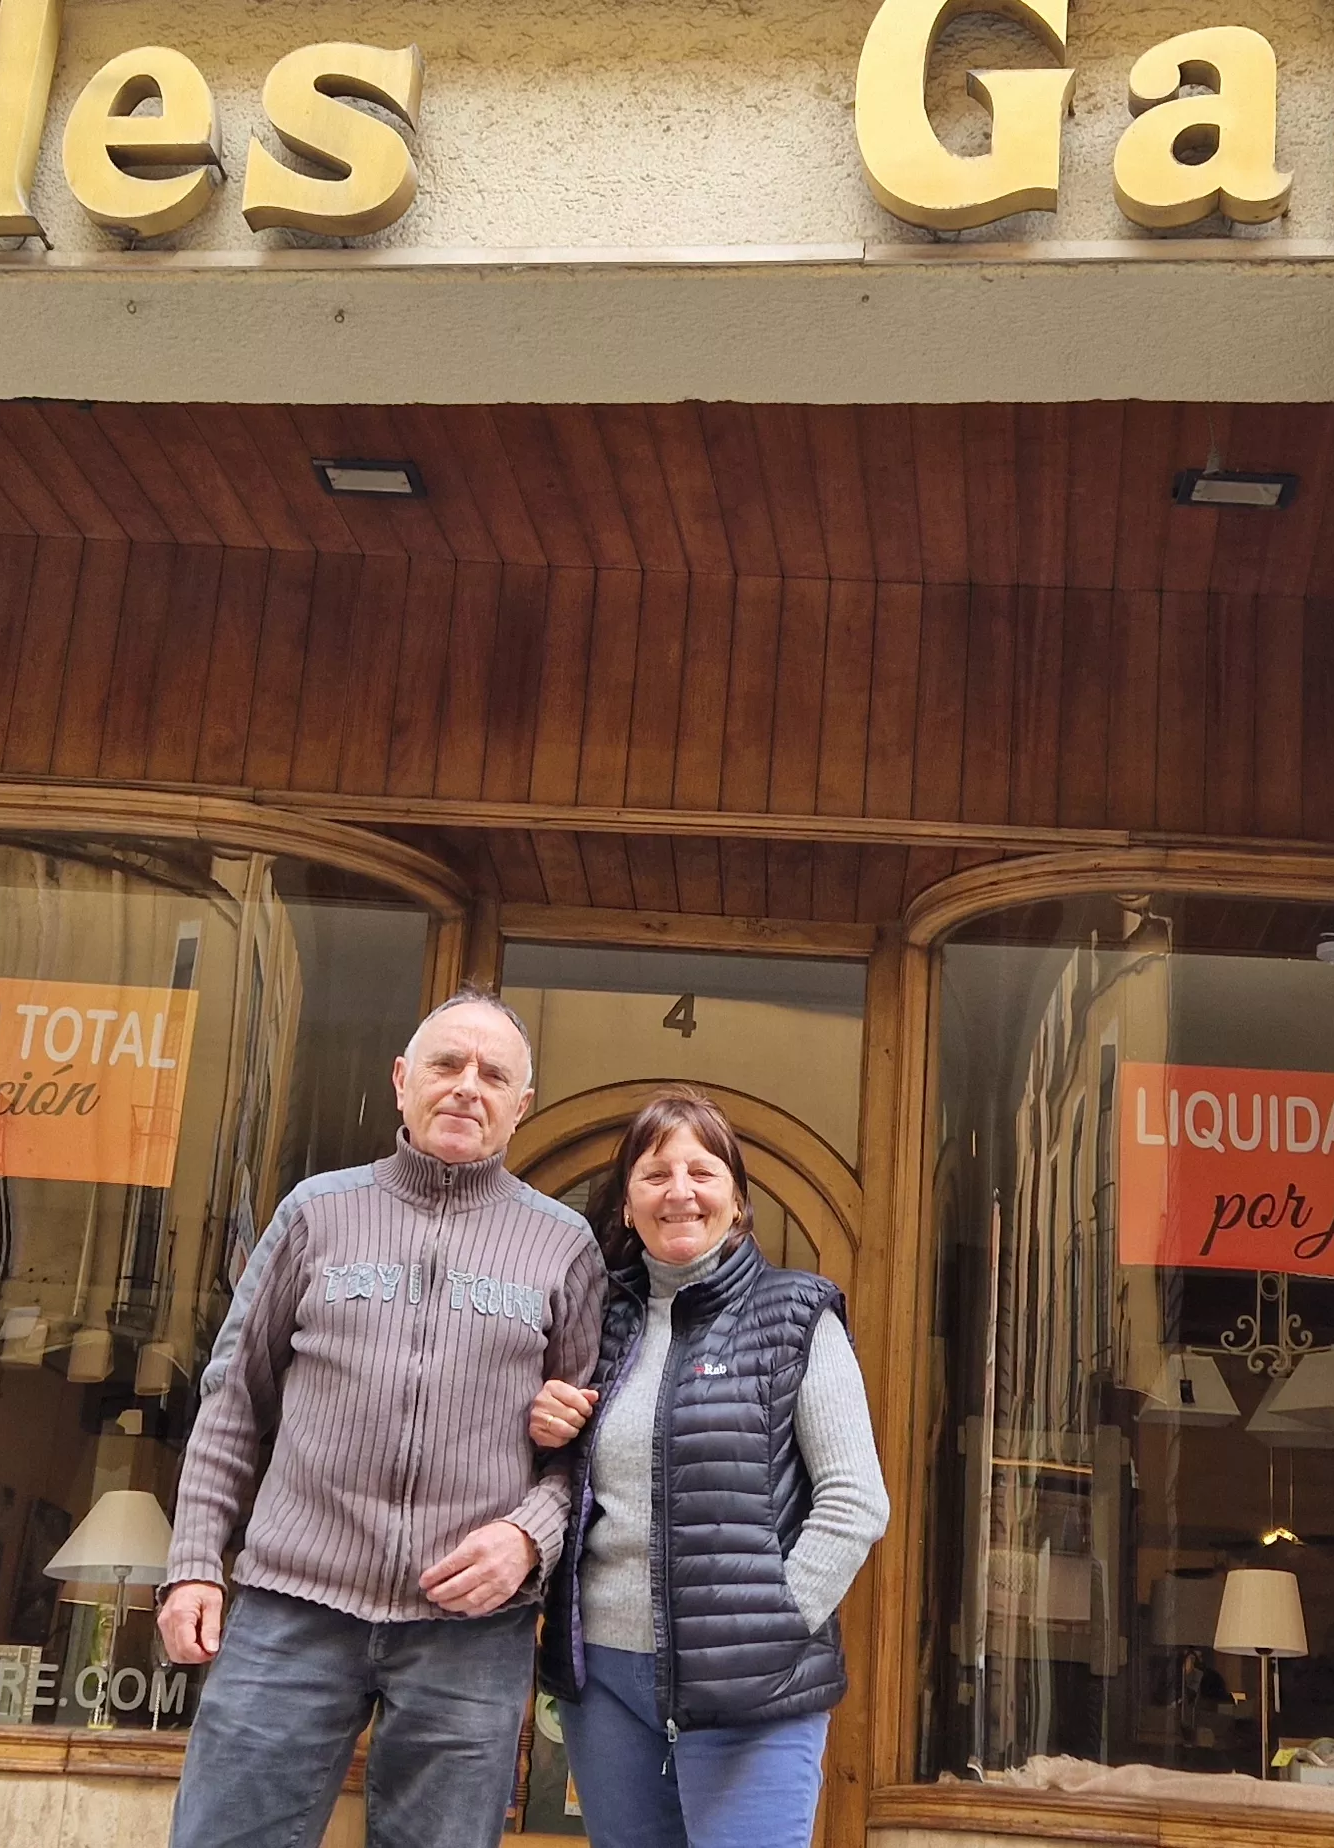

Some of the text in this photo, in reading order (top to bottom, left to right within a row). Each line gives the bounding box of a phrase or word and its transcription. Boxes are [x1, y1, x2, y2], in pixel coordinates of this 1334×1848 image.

[16, 1003, 178, 1069] TOTAL
[663, 993, 697, 1038] 4
[1199, 1183, 1313, 1256] por
[704, 1363, 727, 1375] Rab
